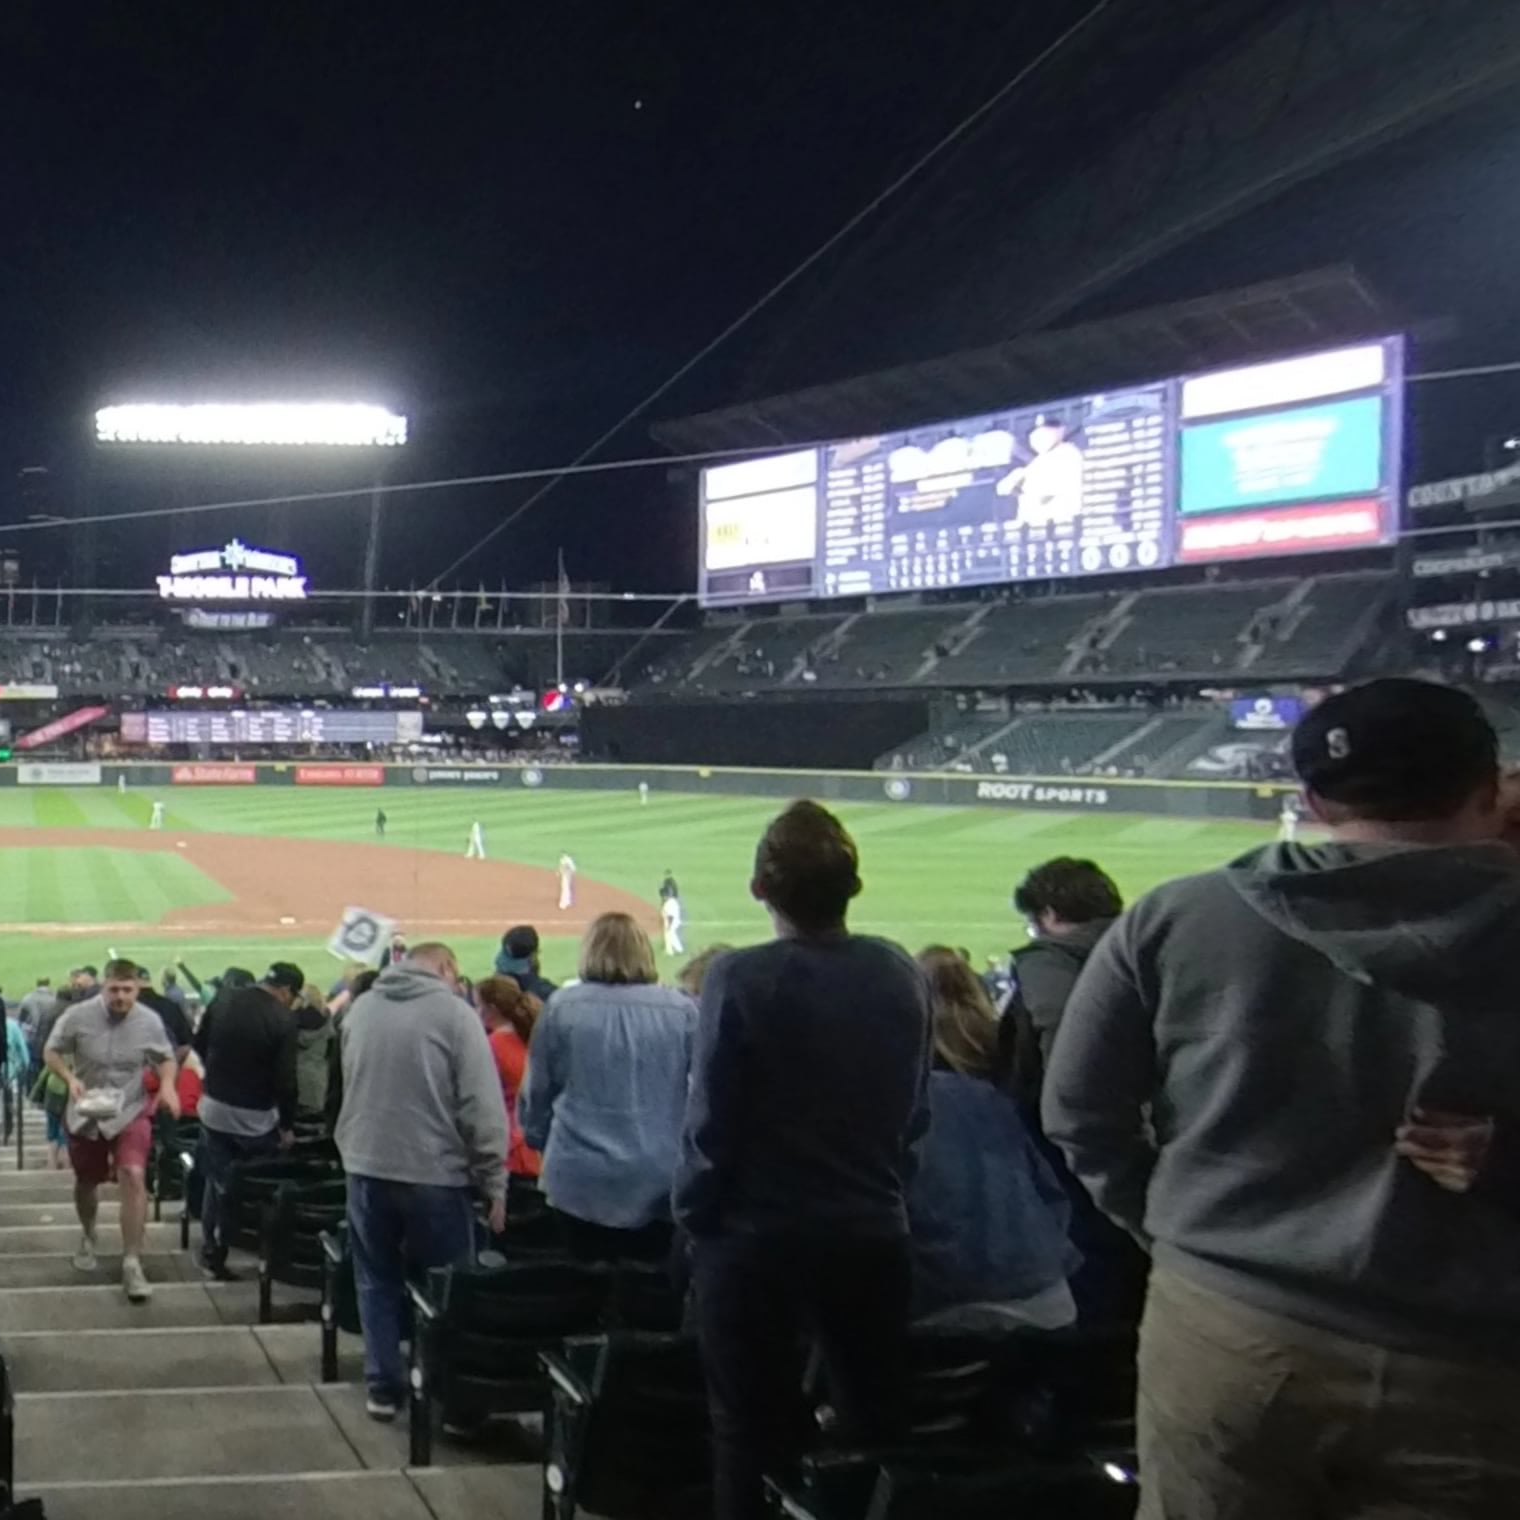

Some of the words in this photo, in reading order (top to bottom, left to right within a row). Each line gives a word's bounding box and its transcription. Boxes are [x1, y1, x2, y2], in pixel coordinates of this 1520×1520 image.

[251, 576, 306, 598] PARK
[977, 782, 1033, 800] ROOT
[1034, 786, 1107, 804] SPORTS
